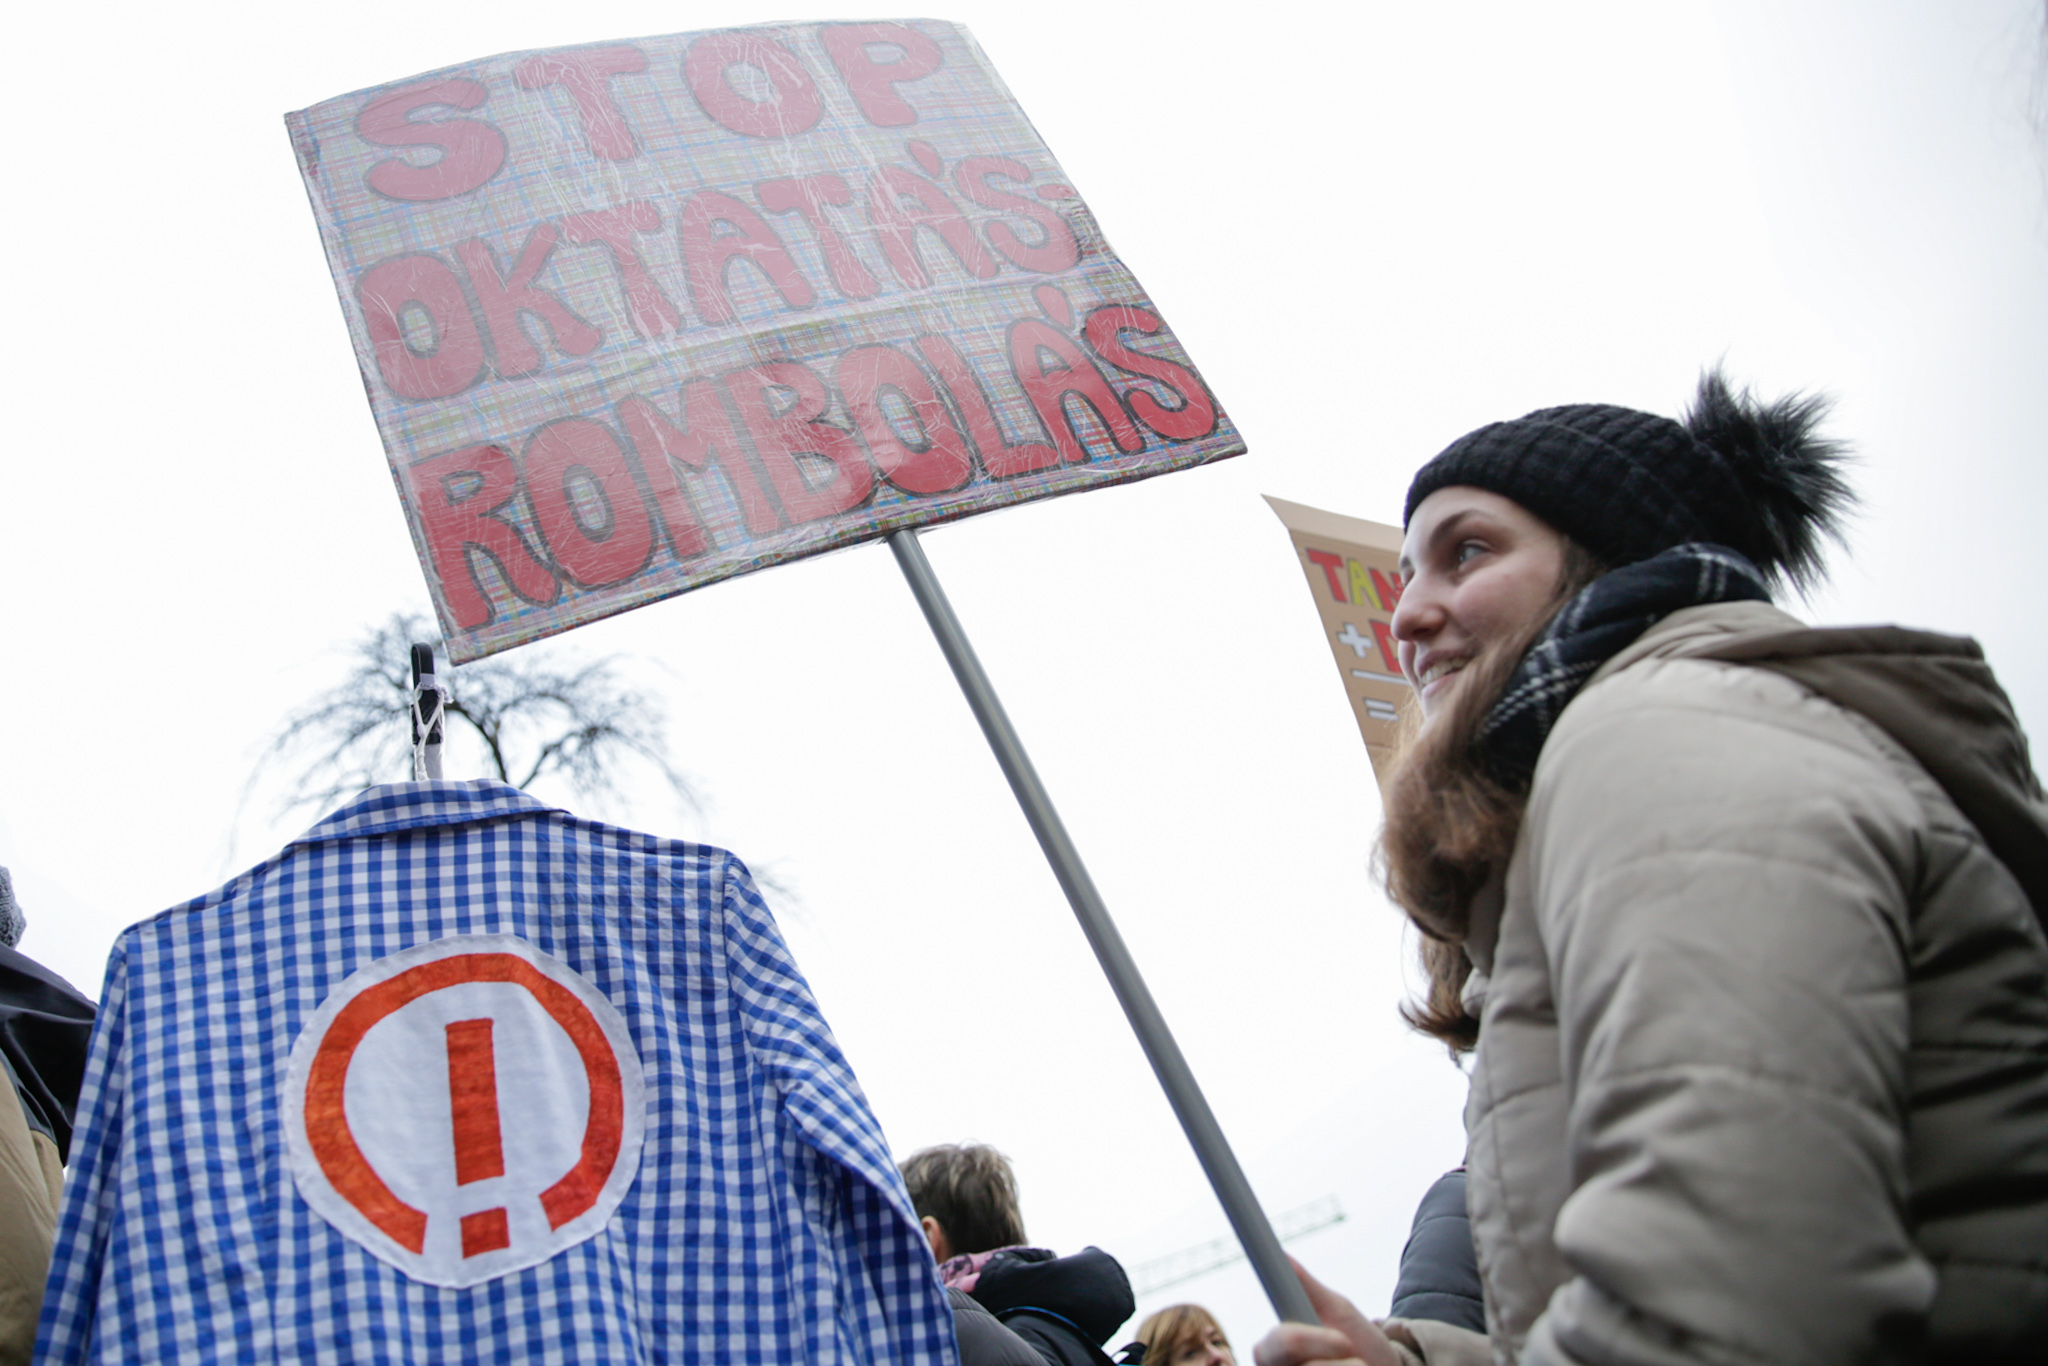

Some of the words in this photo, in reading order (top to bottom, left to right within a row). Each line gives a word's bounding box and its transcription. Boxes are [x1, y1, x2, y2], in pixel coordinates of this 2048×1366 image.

[354, 20, 943, 201] STOP
[353, 139, 1085, 402] OKTATÁS
[408, 284, 1220, 629] ROMBOLÁS
